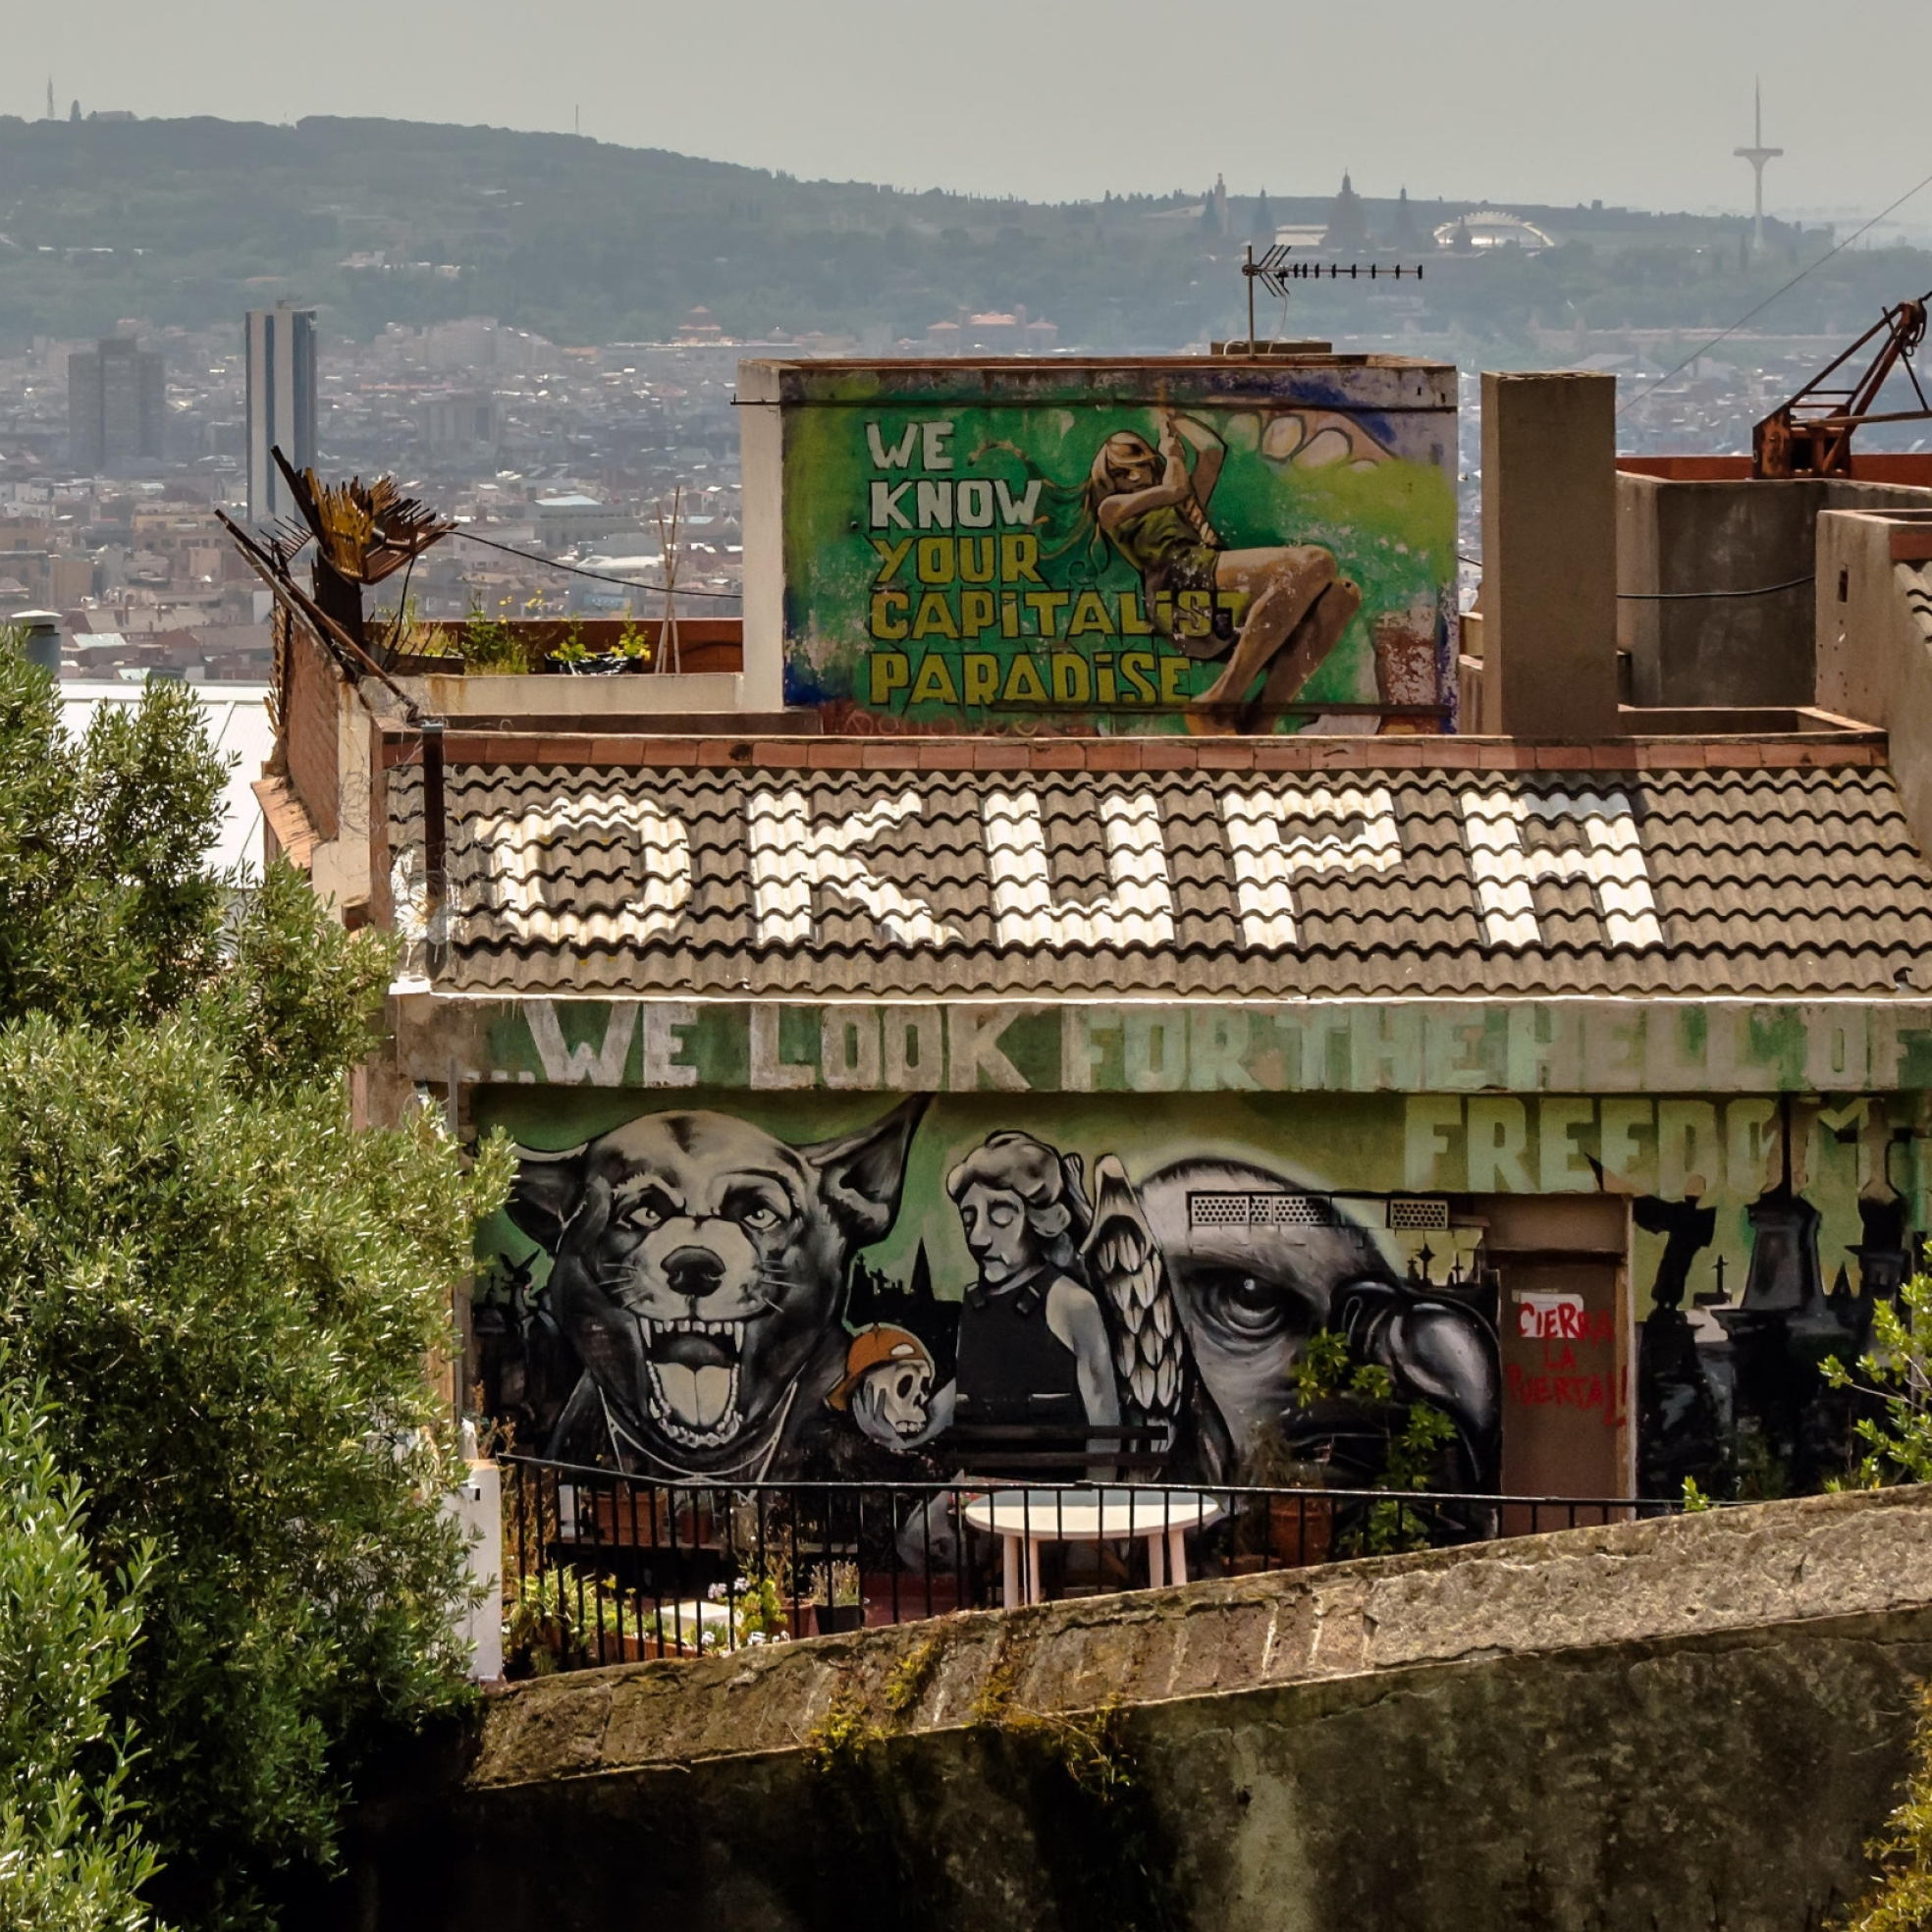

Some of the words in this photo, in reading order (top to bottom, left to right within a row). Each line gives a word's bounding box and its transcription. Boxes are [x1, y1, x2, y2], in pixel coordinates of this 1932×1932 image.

[866, 422, 953, 469] WE
[870, 479, 1043, 528] KNOW
[870, 534, 1043, 584] YOUR
[475, 789, 1664, 949] OKUPA
[750, 1002, 1031, 1092] LOOK
[1061, 1003, 1263, 1092] FOR
[1276, 1003, 1498, 1092] THE
[1506, 1003, 1779, 1092] HELL
[1518, 1302, 1615, 1346] CIERRA
[1544, 1344, 1577, 1371] LA
